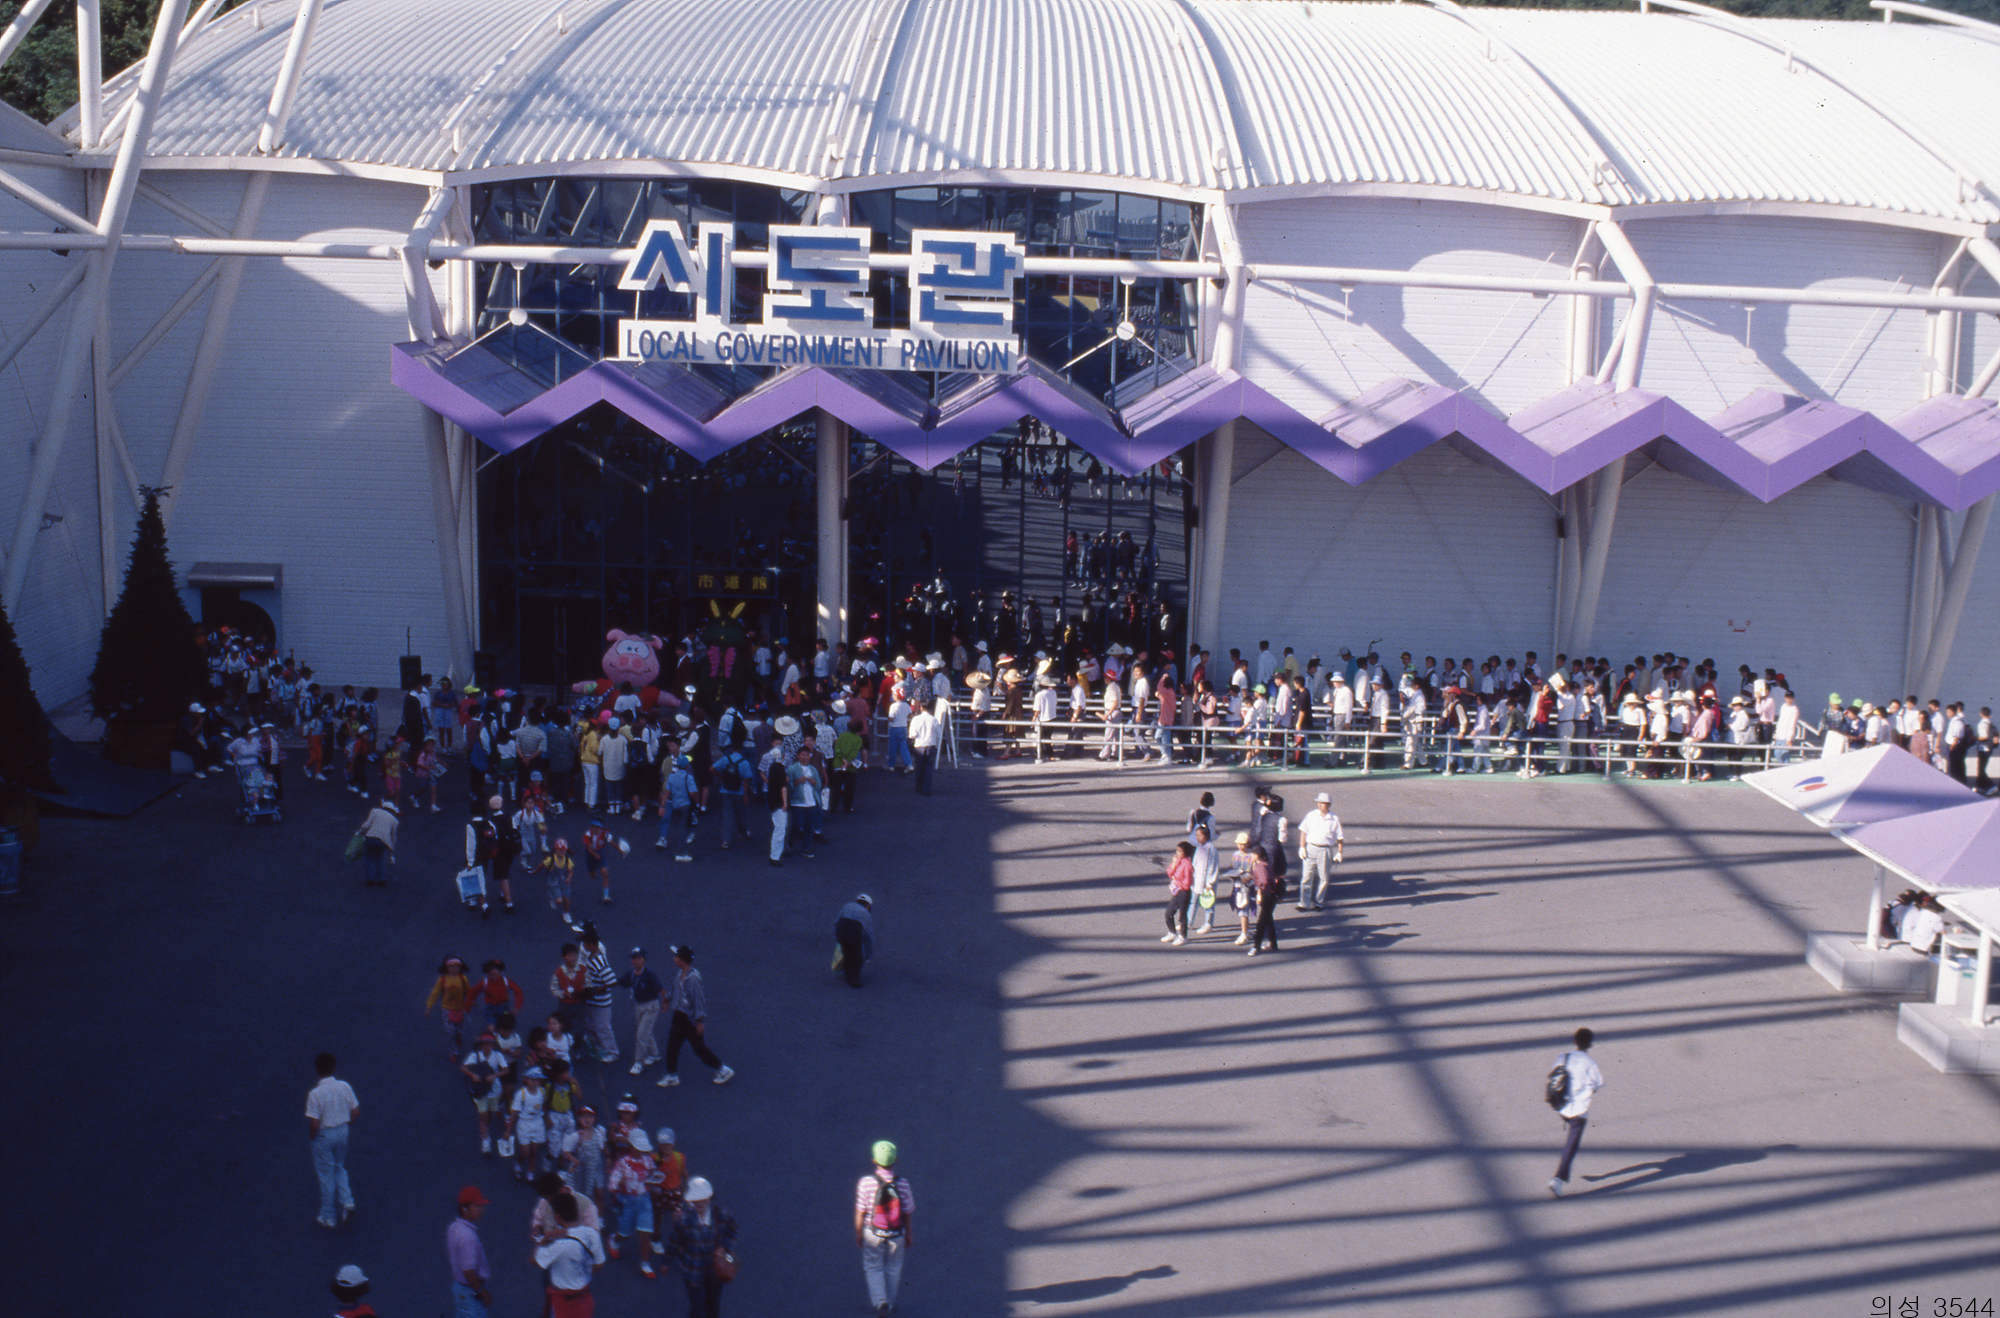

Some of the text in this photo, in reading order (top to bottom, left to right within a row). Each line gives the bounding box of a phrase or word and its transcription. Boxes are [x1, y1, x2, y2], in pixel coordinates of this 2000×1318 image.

[623, 224, 1021, 328] 시도관
[626, 330, 1009, 371] LOCAL GOVERNMENT PAVILION
[698, 574, 768, 590] 市道館
